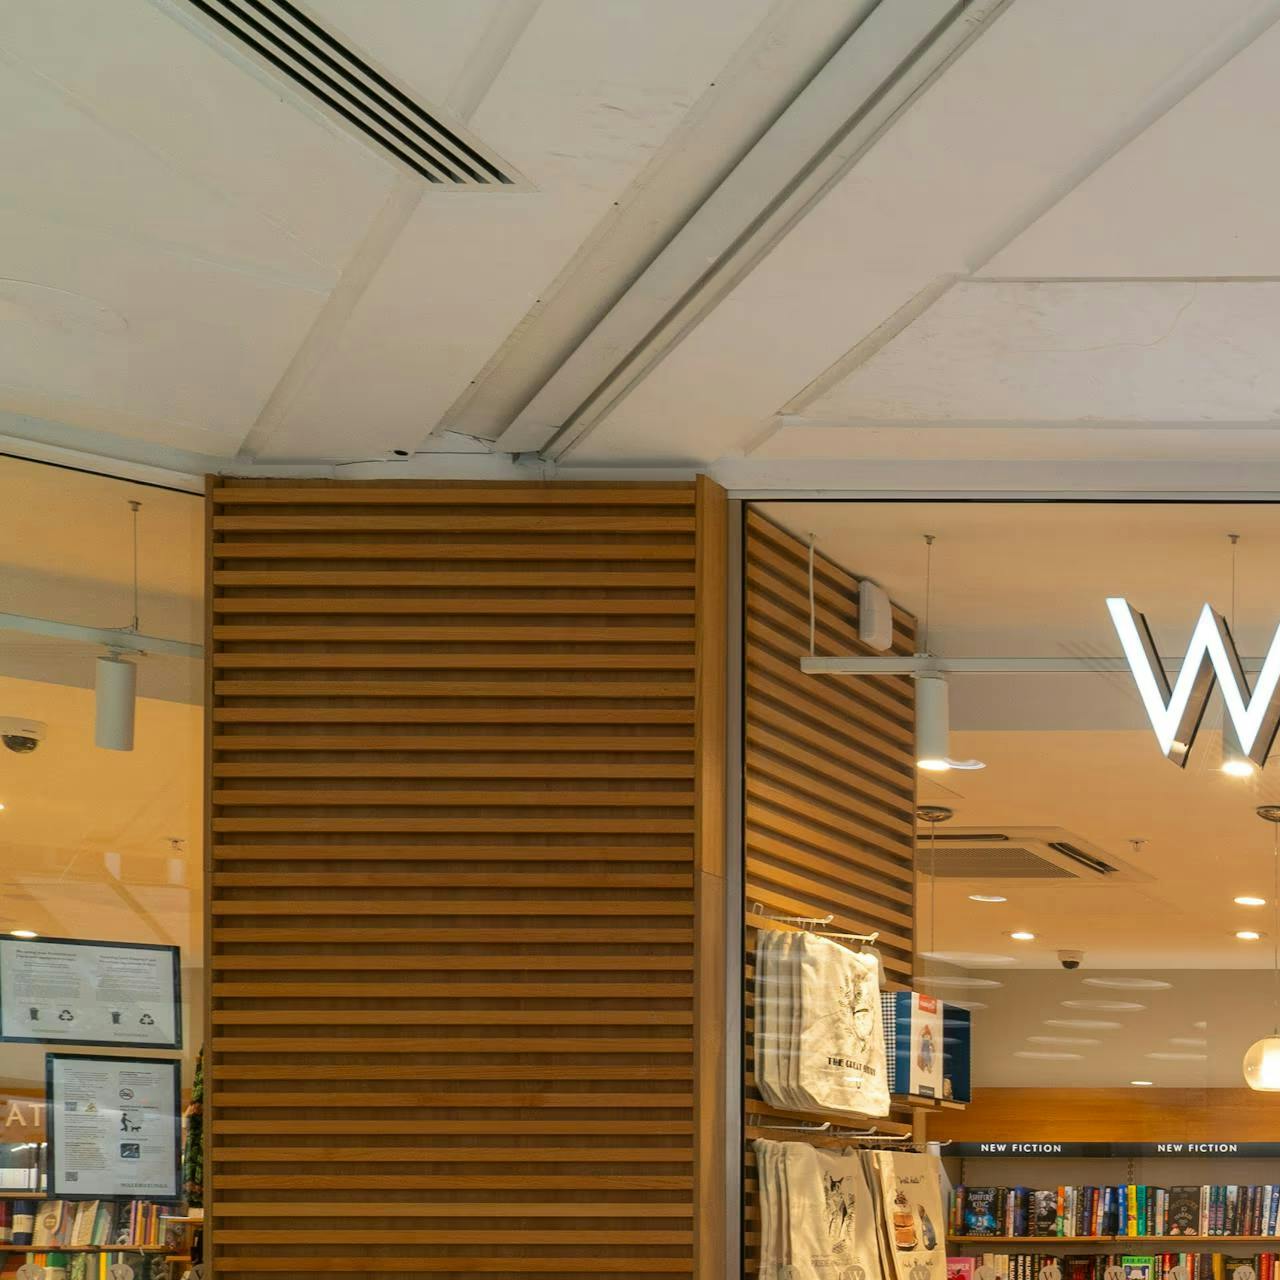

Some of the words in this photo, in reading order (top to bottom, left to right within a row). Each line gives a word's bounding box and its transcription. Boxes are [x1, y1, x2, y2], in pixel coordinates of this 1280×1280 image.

[981, 1143, 1007, 1152] NEW
[1012, 1143, 1062, 1153] FICTION
[1157, 1143, 1183, 1152] NEW
[1188, 1143, 1238, 1153] FICTION
